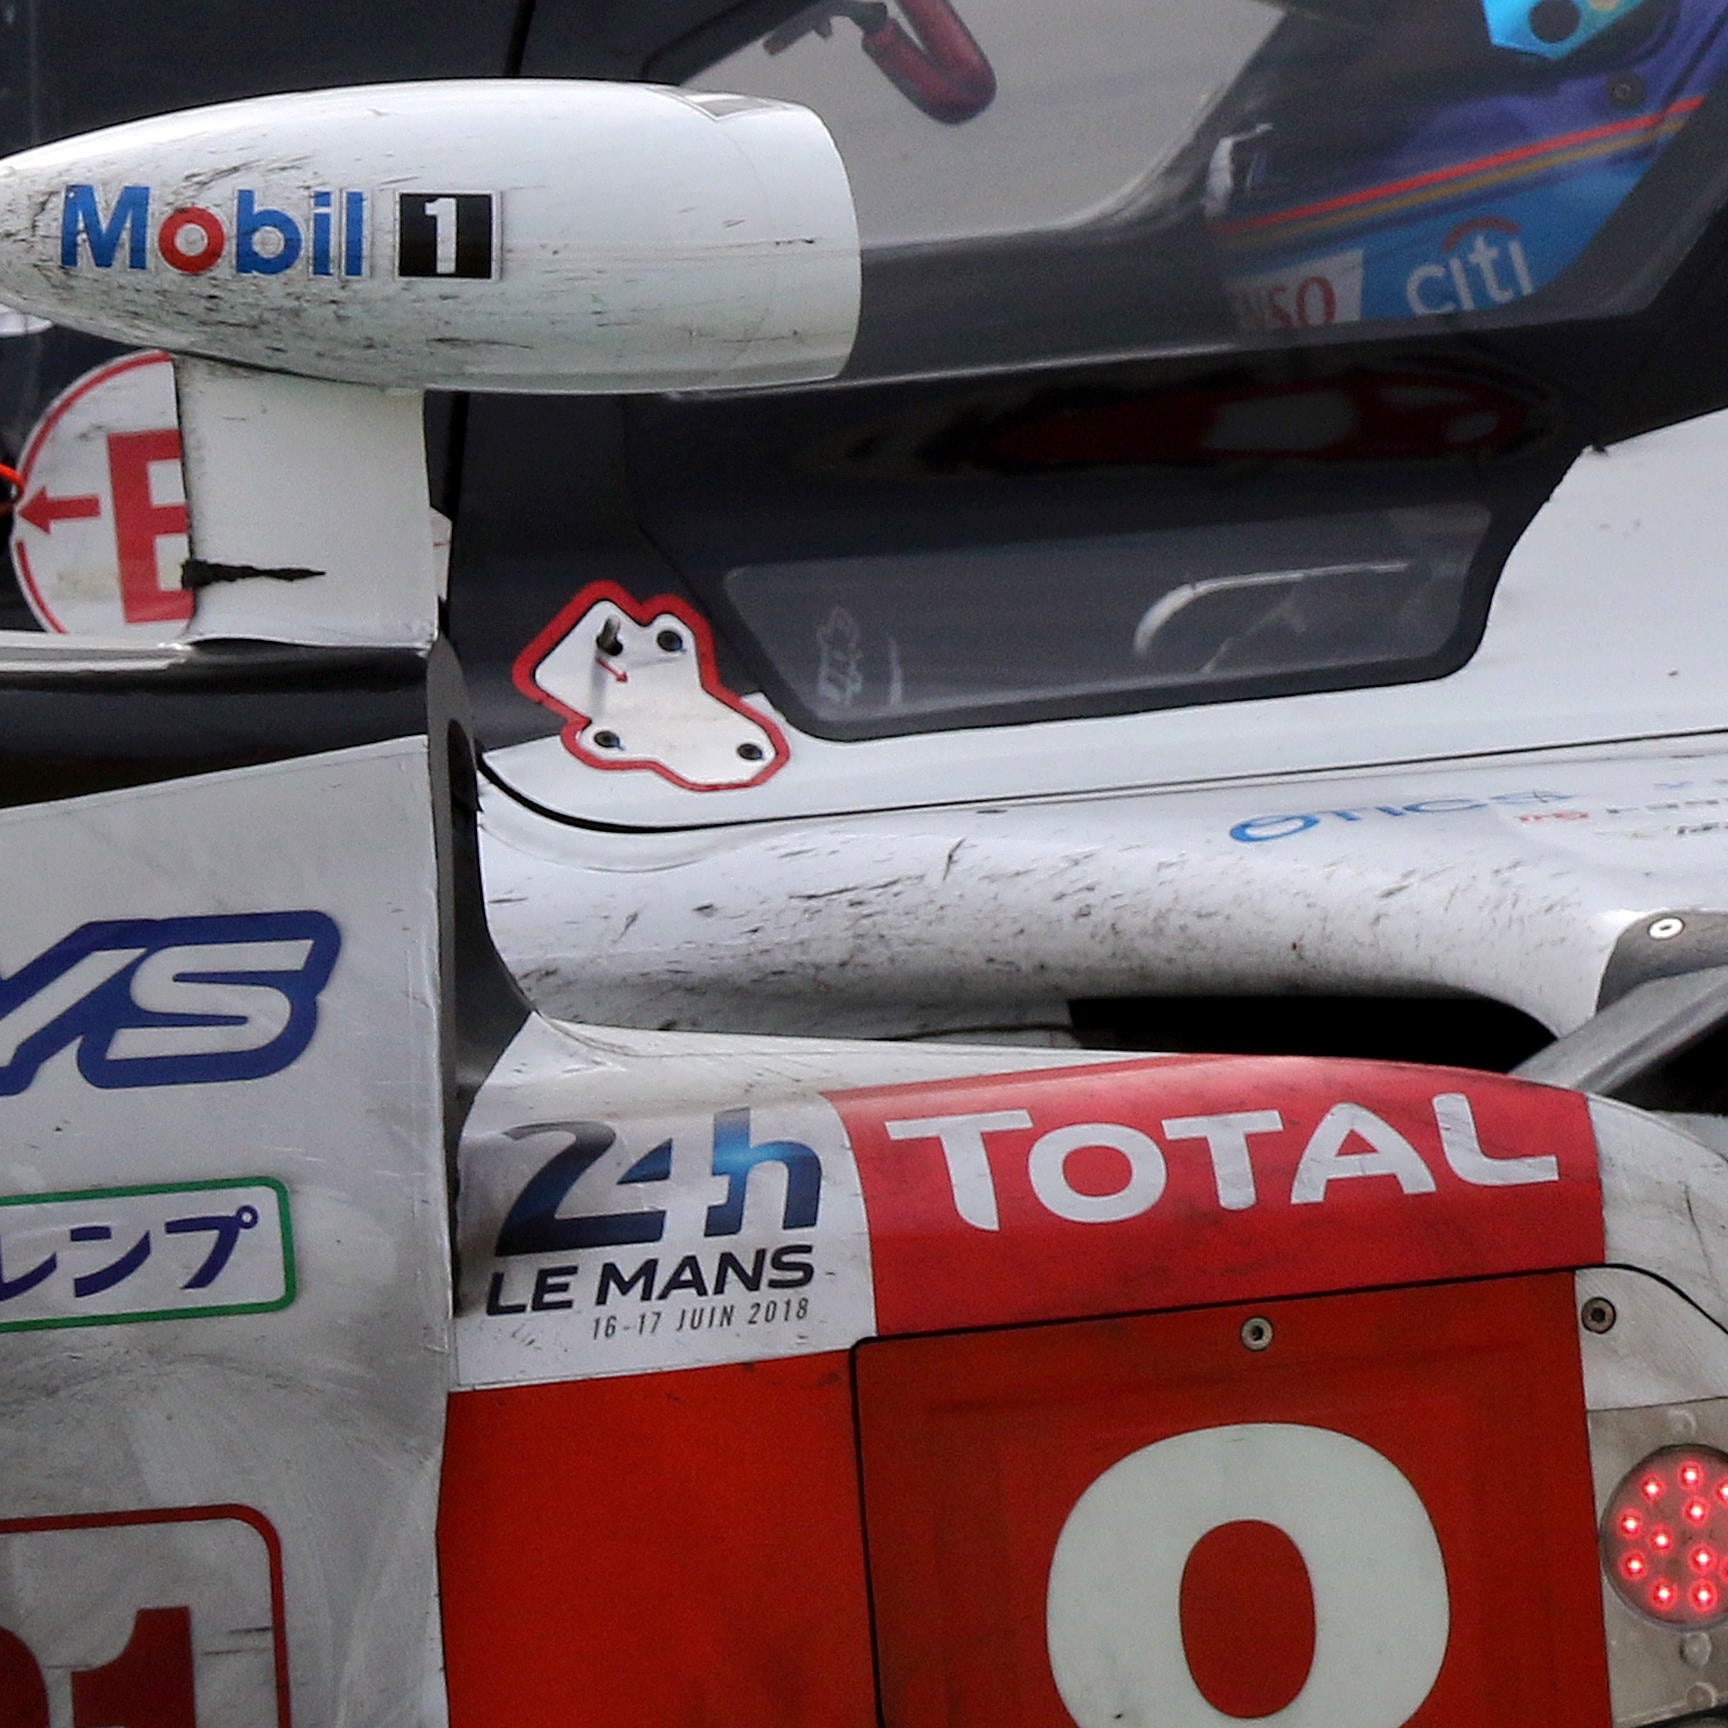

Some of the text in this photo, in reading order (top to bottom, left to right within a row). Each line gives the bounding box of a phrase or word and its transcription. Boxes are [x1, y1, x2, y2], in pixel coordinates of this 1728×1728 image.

[59, 183, 368, 278] Mobil
[1405, 232, 1534, 318] citi
[494, 1106, 824, 1259] 24h
[883, 1091, 1561, 1232] TOTAL
[485, 1245, 817, 1317] LE MANS
[592, 1297, 810, 1341] 16-17 JUIN 2018
